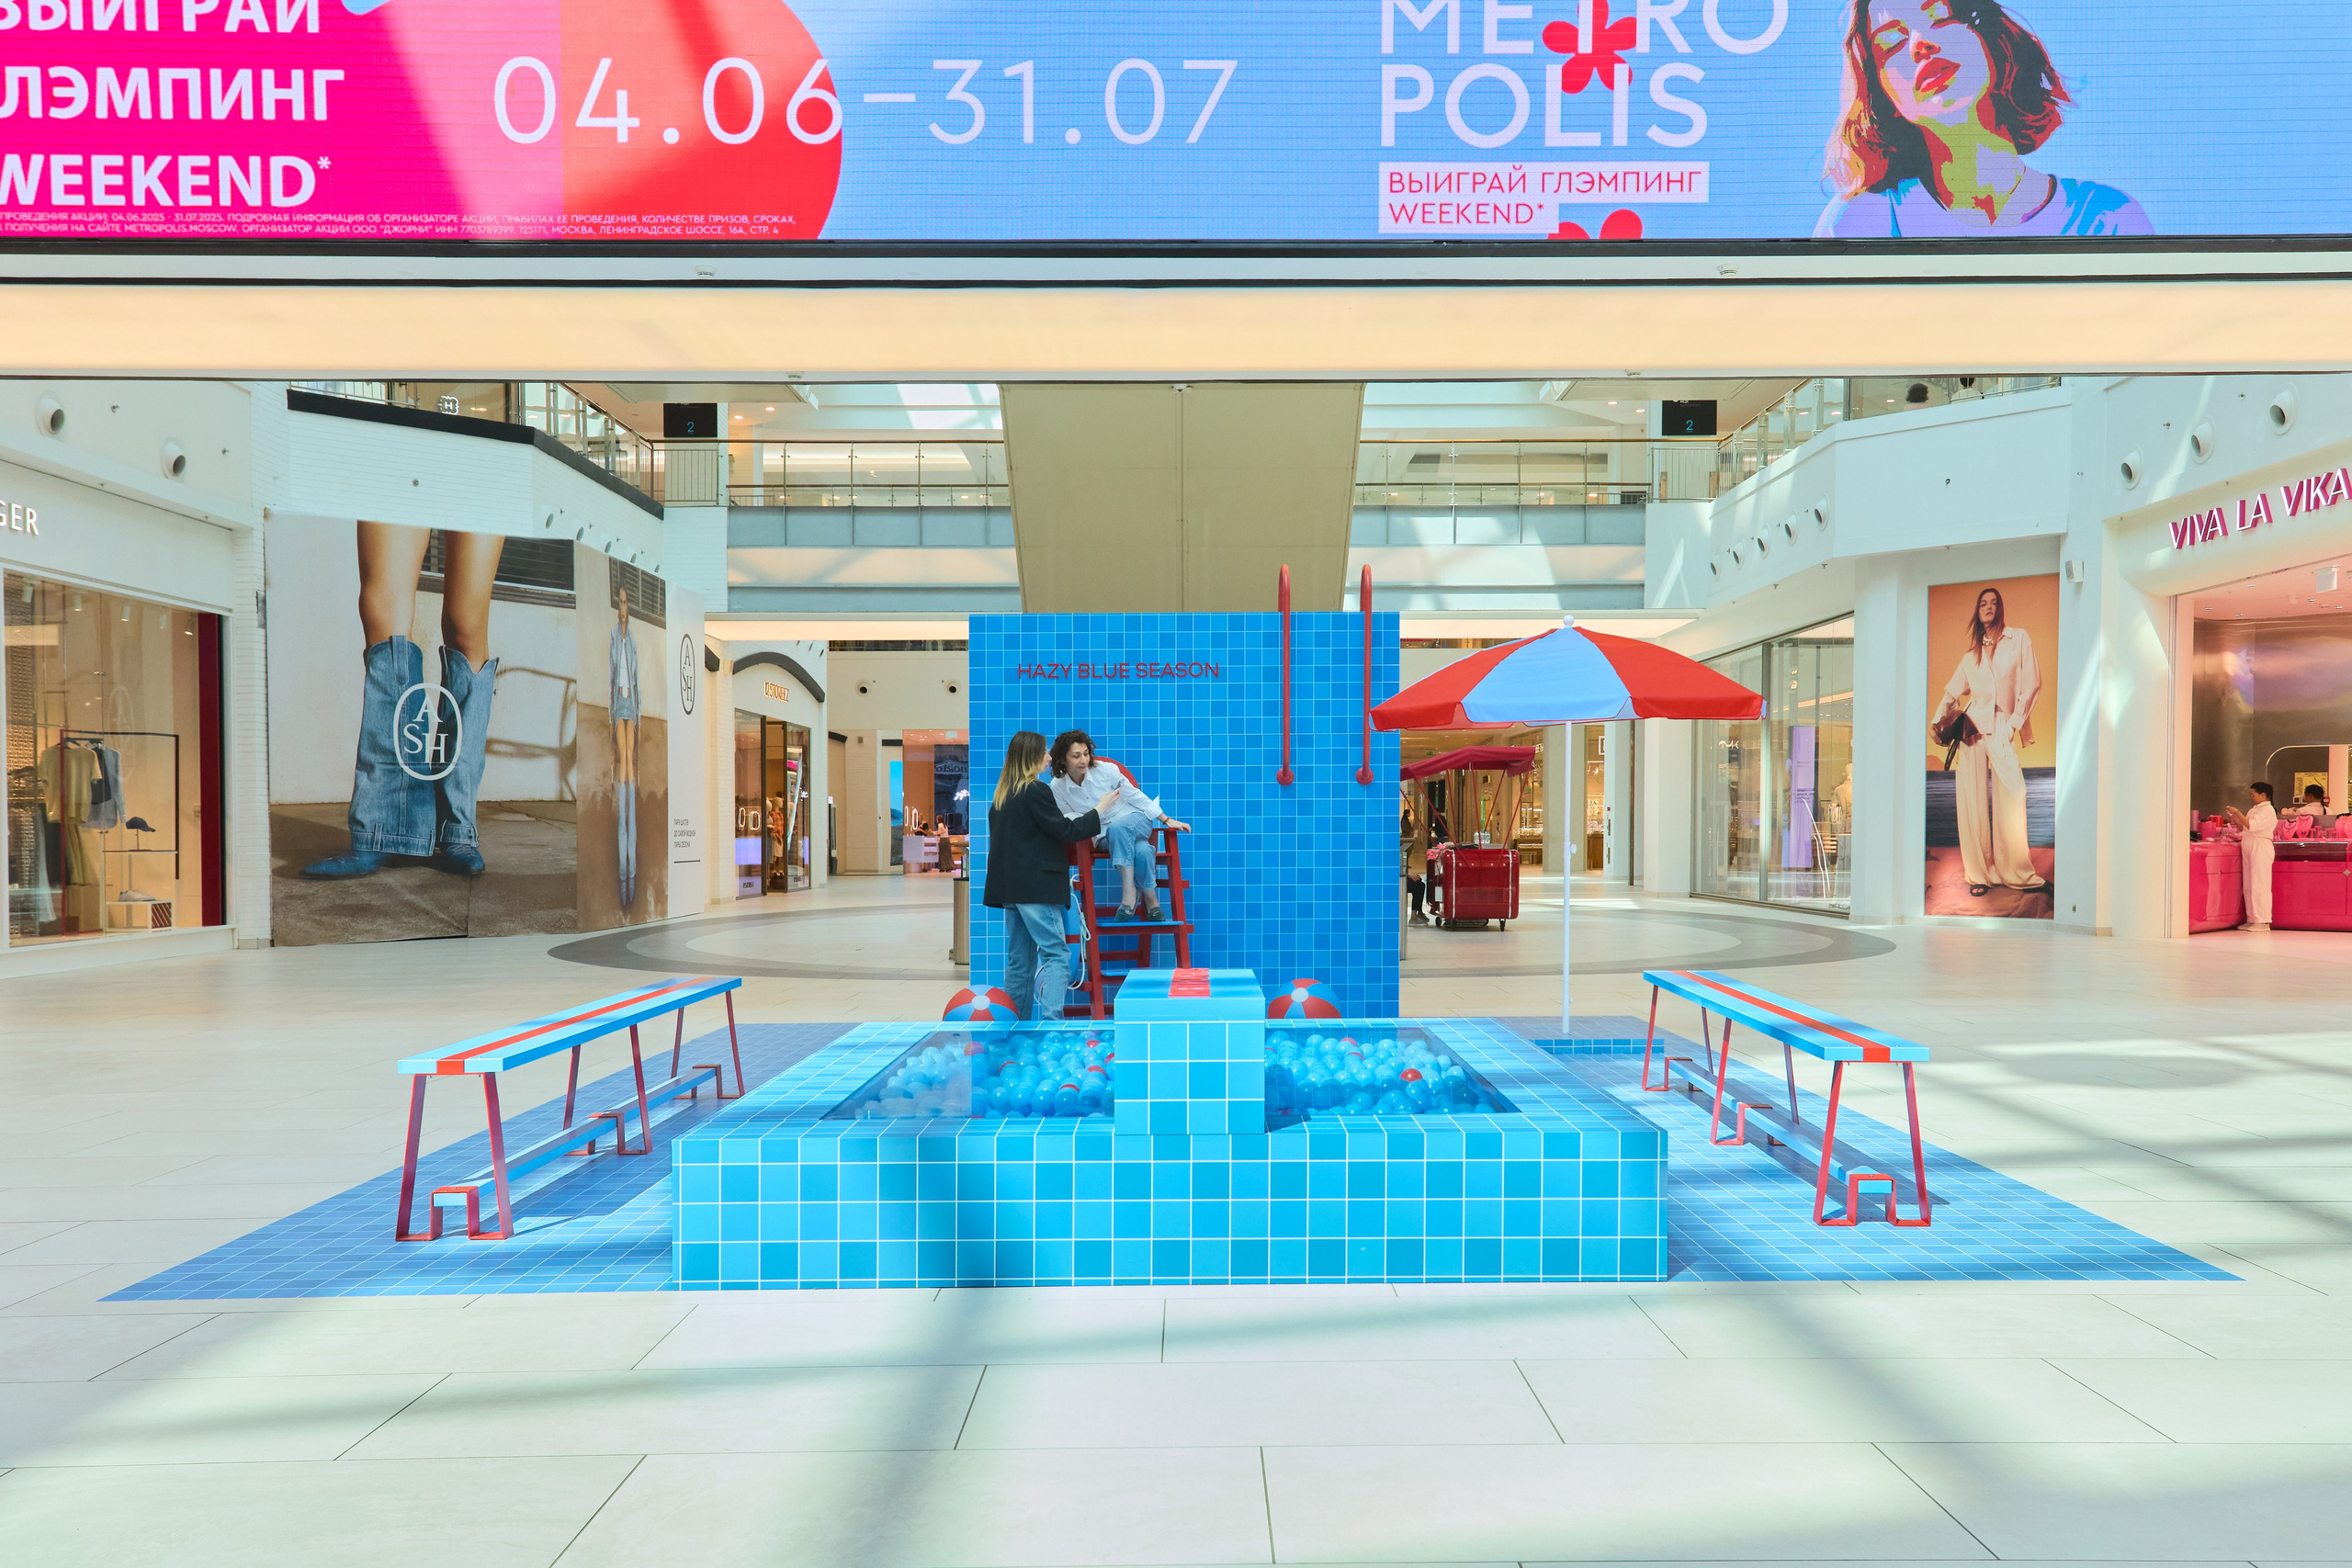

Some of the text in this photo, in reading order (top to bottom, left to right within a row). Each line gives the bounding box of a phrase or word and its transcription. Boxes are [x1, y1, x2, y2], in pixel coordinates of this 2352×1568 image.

[1381, 62, 1708, 148] POLIS
[1388, 164, 1702, 194] ВЫИГРАЙ ГЛЭМПИНГ
[111, 212, 165, 221] 04.06.2025
[174, 212, 225, 222] 31.07.2025.
[229, 213, 290, 223] ПОДРОБНАЯ
[292, 213, 364, 223] ИНФОРМАЦИЯ
[367, 214, 381, 222] ОБ
[384, 214, 458, 223] ОРГАНИЗАТОРЕ
[462, 215, 499, 224] АКЦИИ,
[503, 215, 554, 223] ПРАВИЛАХ
[557, 215, 568, 223] ЕЕ
[571, 215, 639, 224] ПРОВЕДЕНИЯ,
[642, 215, 706, 223] КОЛИЧЕСТВЕ
[708, 215, 751, 224] ПРИЗОВ,
[753, 215, 796, 224] СРОКАХ,
[5, 223, 68, 232] ПОЛУЧЕНИЯ
[87, 221, 122, 232] САЙТЕ
[242, 224, 311, 233] ОРГАНИЗАТОР
[314, 225, 349, 234] АКЦИИ
[352, 225, 377, 233] ООО
[551, 226, 596, 235] МОСКВА,
[599, 226, 683, 234] ЛЕНИНГРАДСКОЕ
[686, 226, 726, 235] ШОССЕ,
[729, 226, 747, 235] 16А,
[750, 226, 770, 234] СТР.
[773, 226, 779, 234] 4
[686, 421, 695, 433] 2
[1686, 419, 1693, 431] 2
[2168, 468, 2352, 549] VIVA LA VIKA
[1018, 661, 1220, 679] HAZY BLUE SEASON
